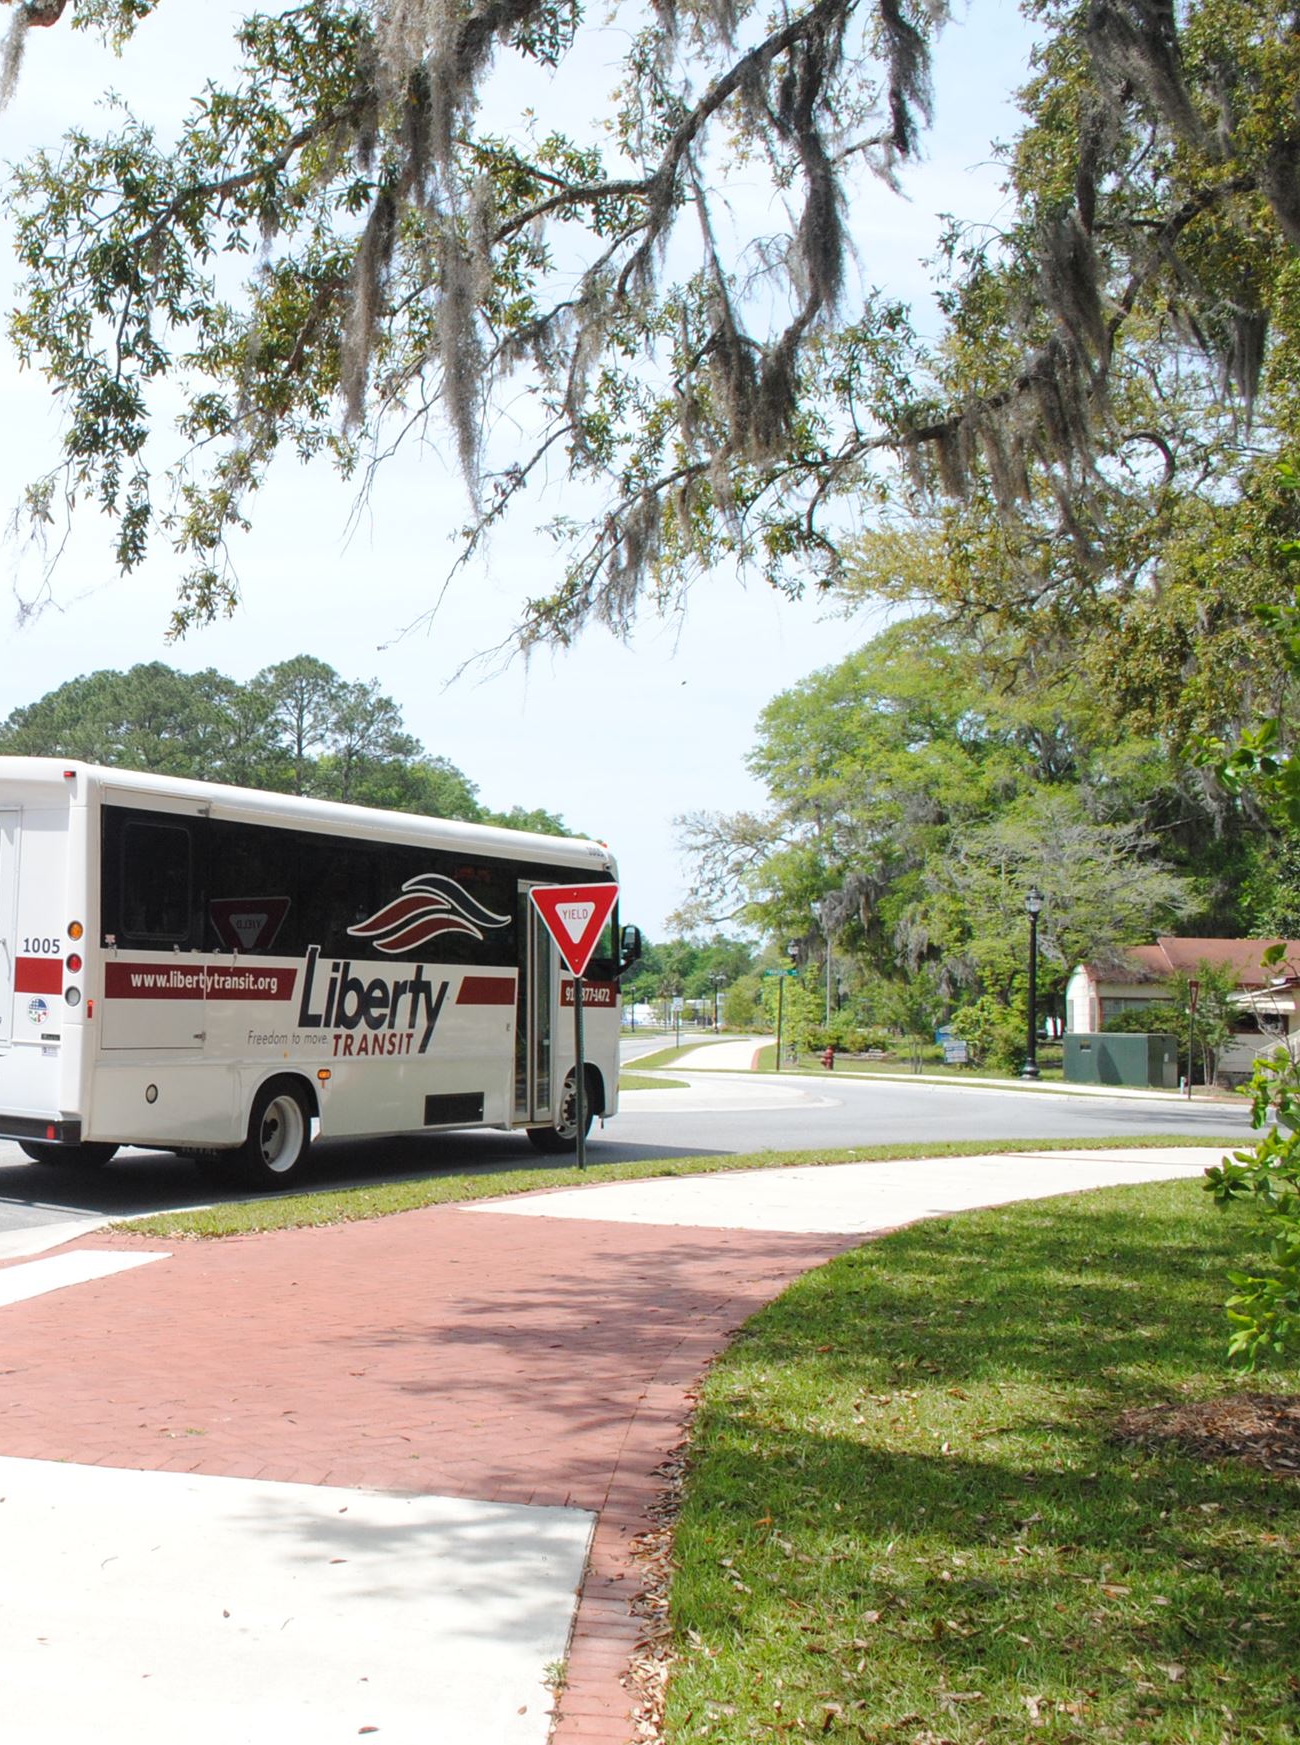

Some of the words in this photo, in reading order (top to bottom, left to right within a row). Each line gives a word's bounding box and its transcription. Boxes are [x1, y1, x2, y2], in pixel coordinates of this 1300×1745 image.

[562, 909, 589, 920] YIELD
[23, 938, 61, 954] 1005
[130, 971, 279, 994] www.libertytransit.org
[297, 944, 450, 1055] Liberty
[247, 1030, 288, 1046] Freedom
[292, 1031, 301, 1045] to
[332, 1033, 415, 1056] TRANSIT
